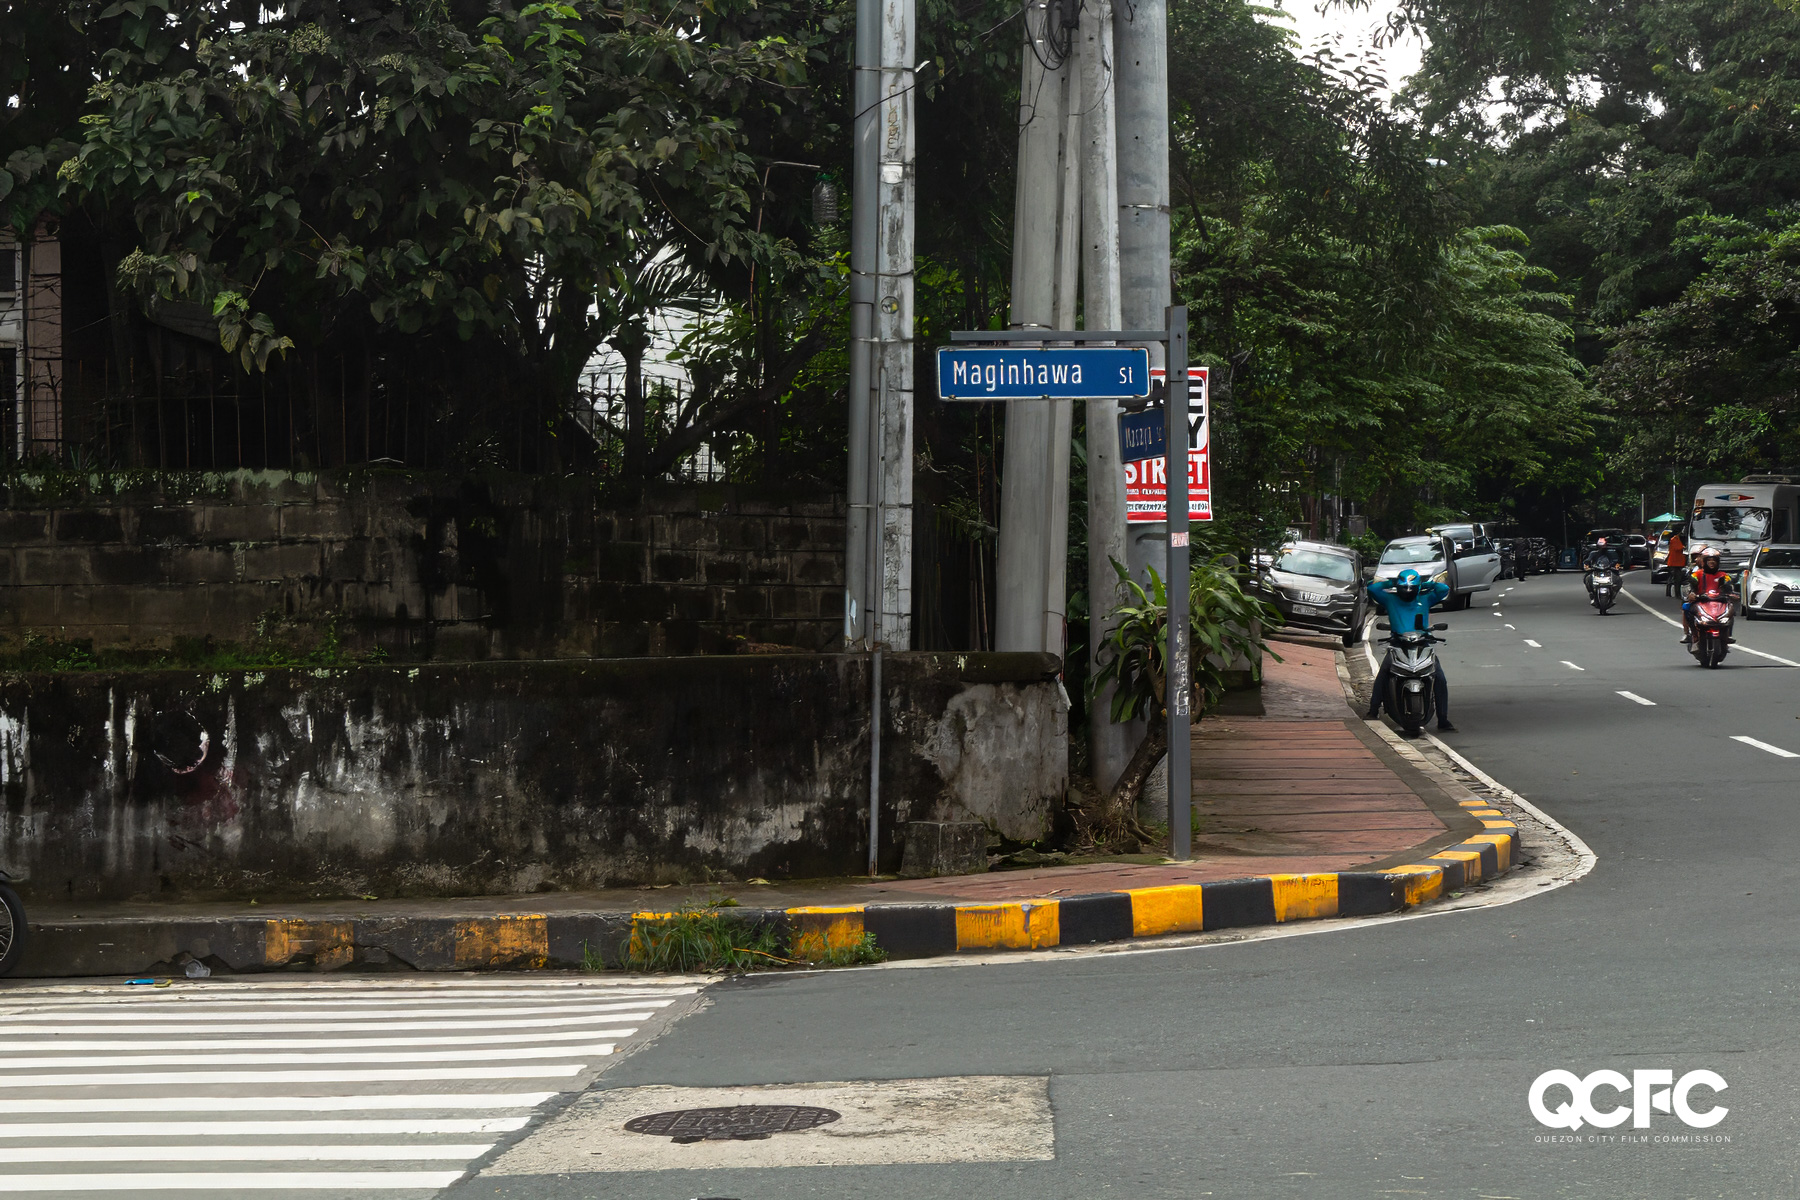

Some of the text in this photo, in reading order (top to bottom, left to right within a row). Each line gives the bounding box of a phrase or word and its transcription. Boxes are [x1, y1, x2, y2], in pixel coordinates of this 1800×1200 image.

[953, 358, 1133, 392] Maginhawa St
[1125, 454, 1207, 484] STRT
